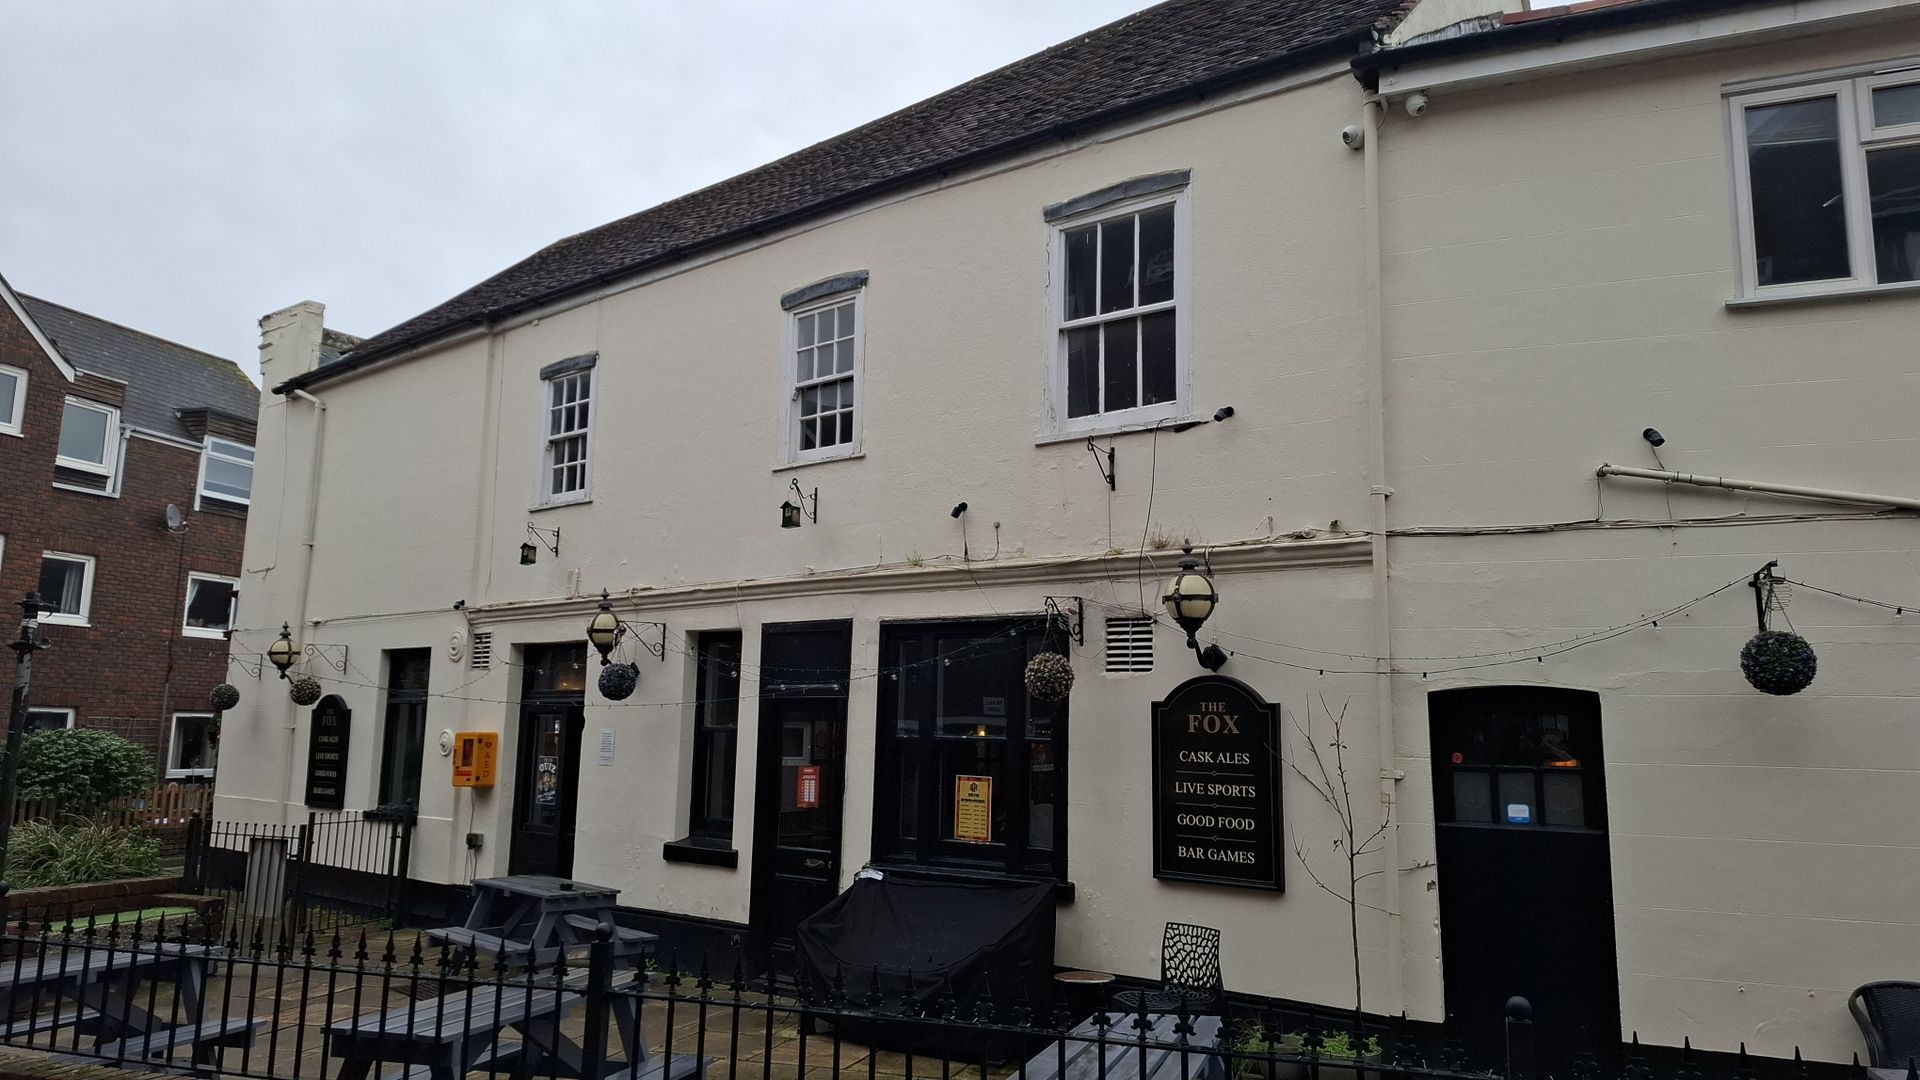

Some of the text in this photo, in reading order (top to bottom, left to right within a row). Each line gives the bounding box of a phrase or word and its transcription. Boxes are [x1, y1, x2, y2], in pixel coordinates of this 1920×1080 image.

[1199, 701, 1226, 713] THE
[1187, 714, 1241, 734] FOX
[1179, 750, 1250, 765] CASK ALES
[539, 762, 557, 774] QUIZ
[1175, 781, 1256, 798] LIVE SPORTS
[1177, 813, 1255, 831] GOOD FOOD
[1178, 846, 1255, 864] BAR GAMES
